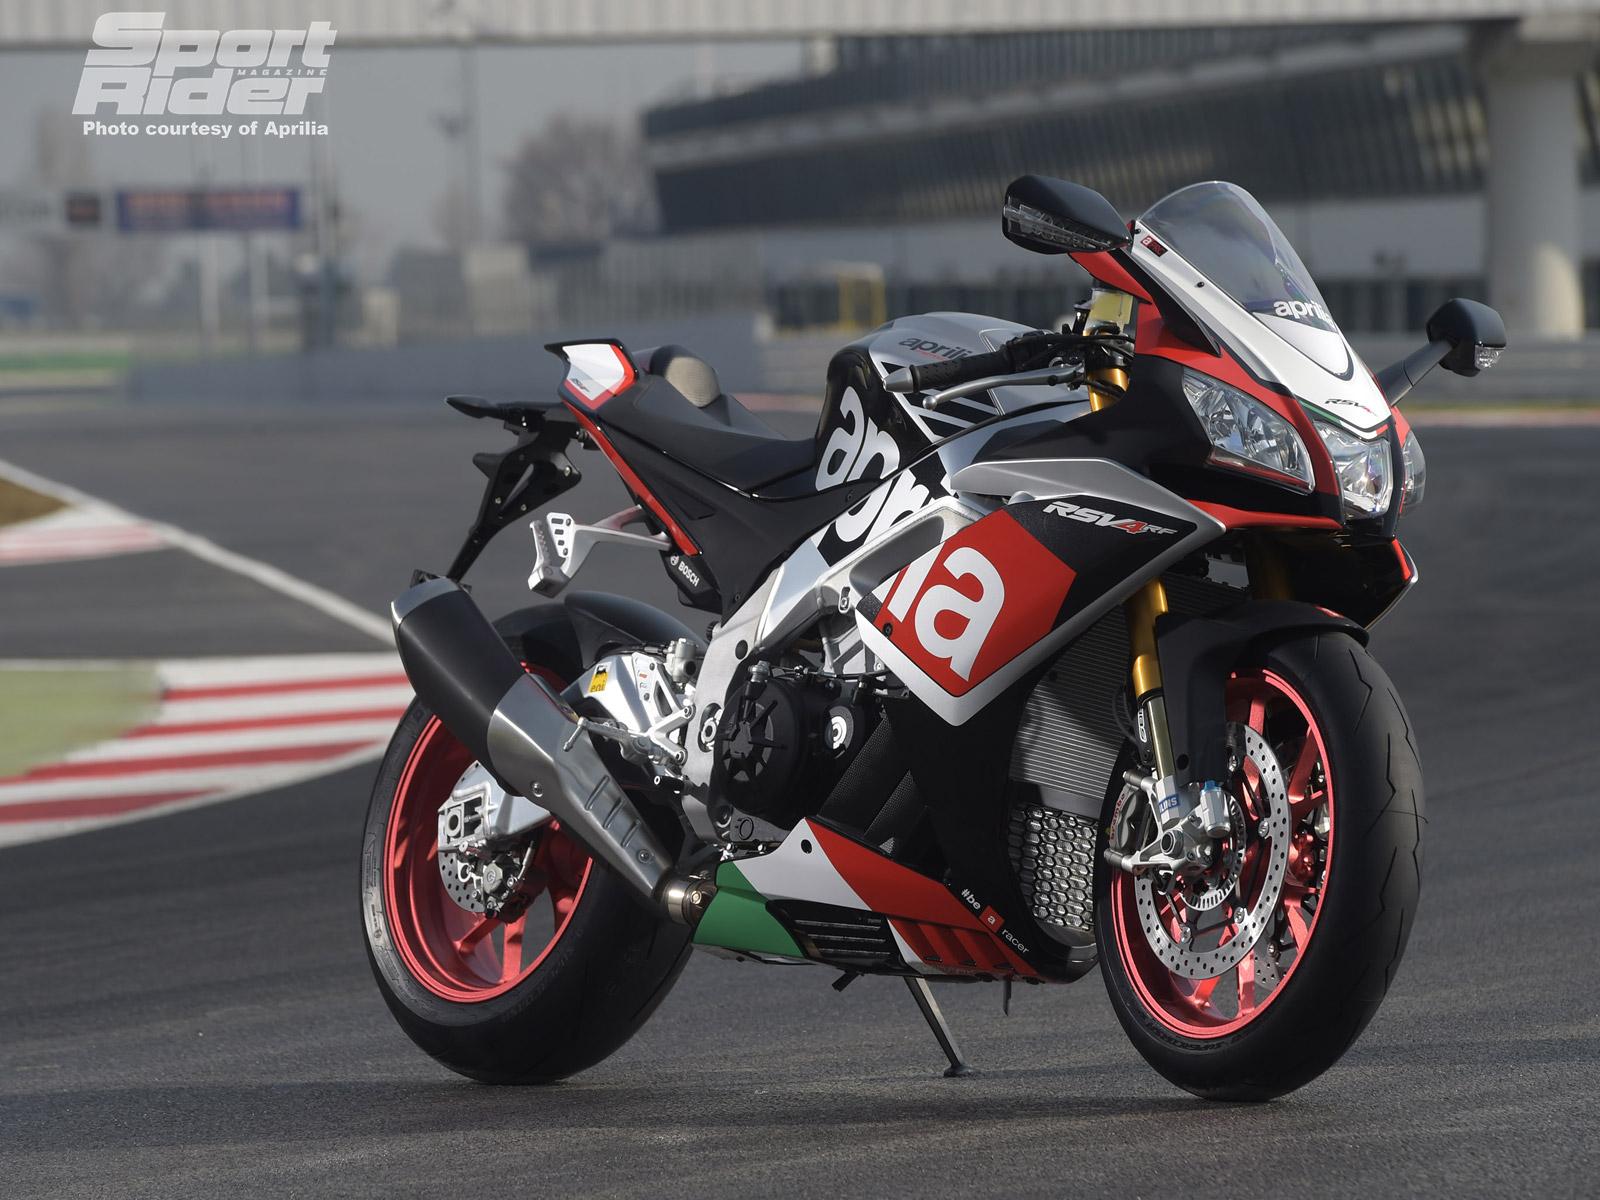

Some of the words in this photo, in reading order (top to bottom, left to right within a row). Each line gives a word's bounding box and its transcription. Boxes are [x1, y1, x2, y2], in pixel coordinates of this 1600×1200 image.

[898, 337, 973, 360] aprili
[678, 560, 700, 587] BOSCH
[961, 888, 981, 910] #be
[1001, 928, 1030, 953] racer
